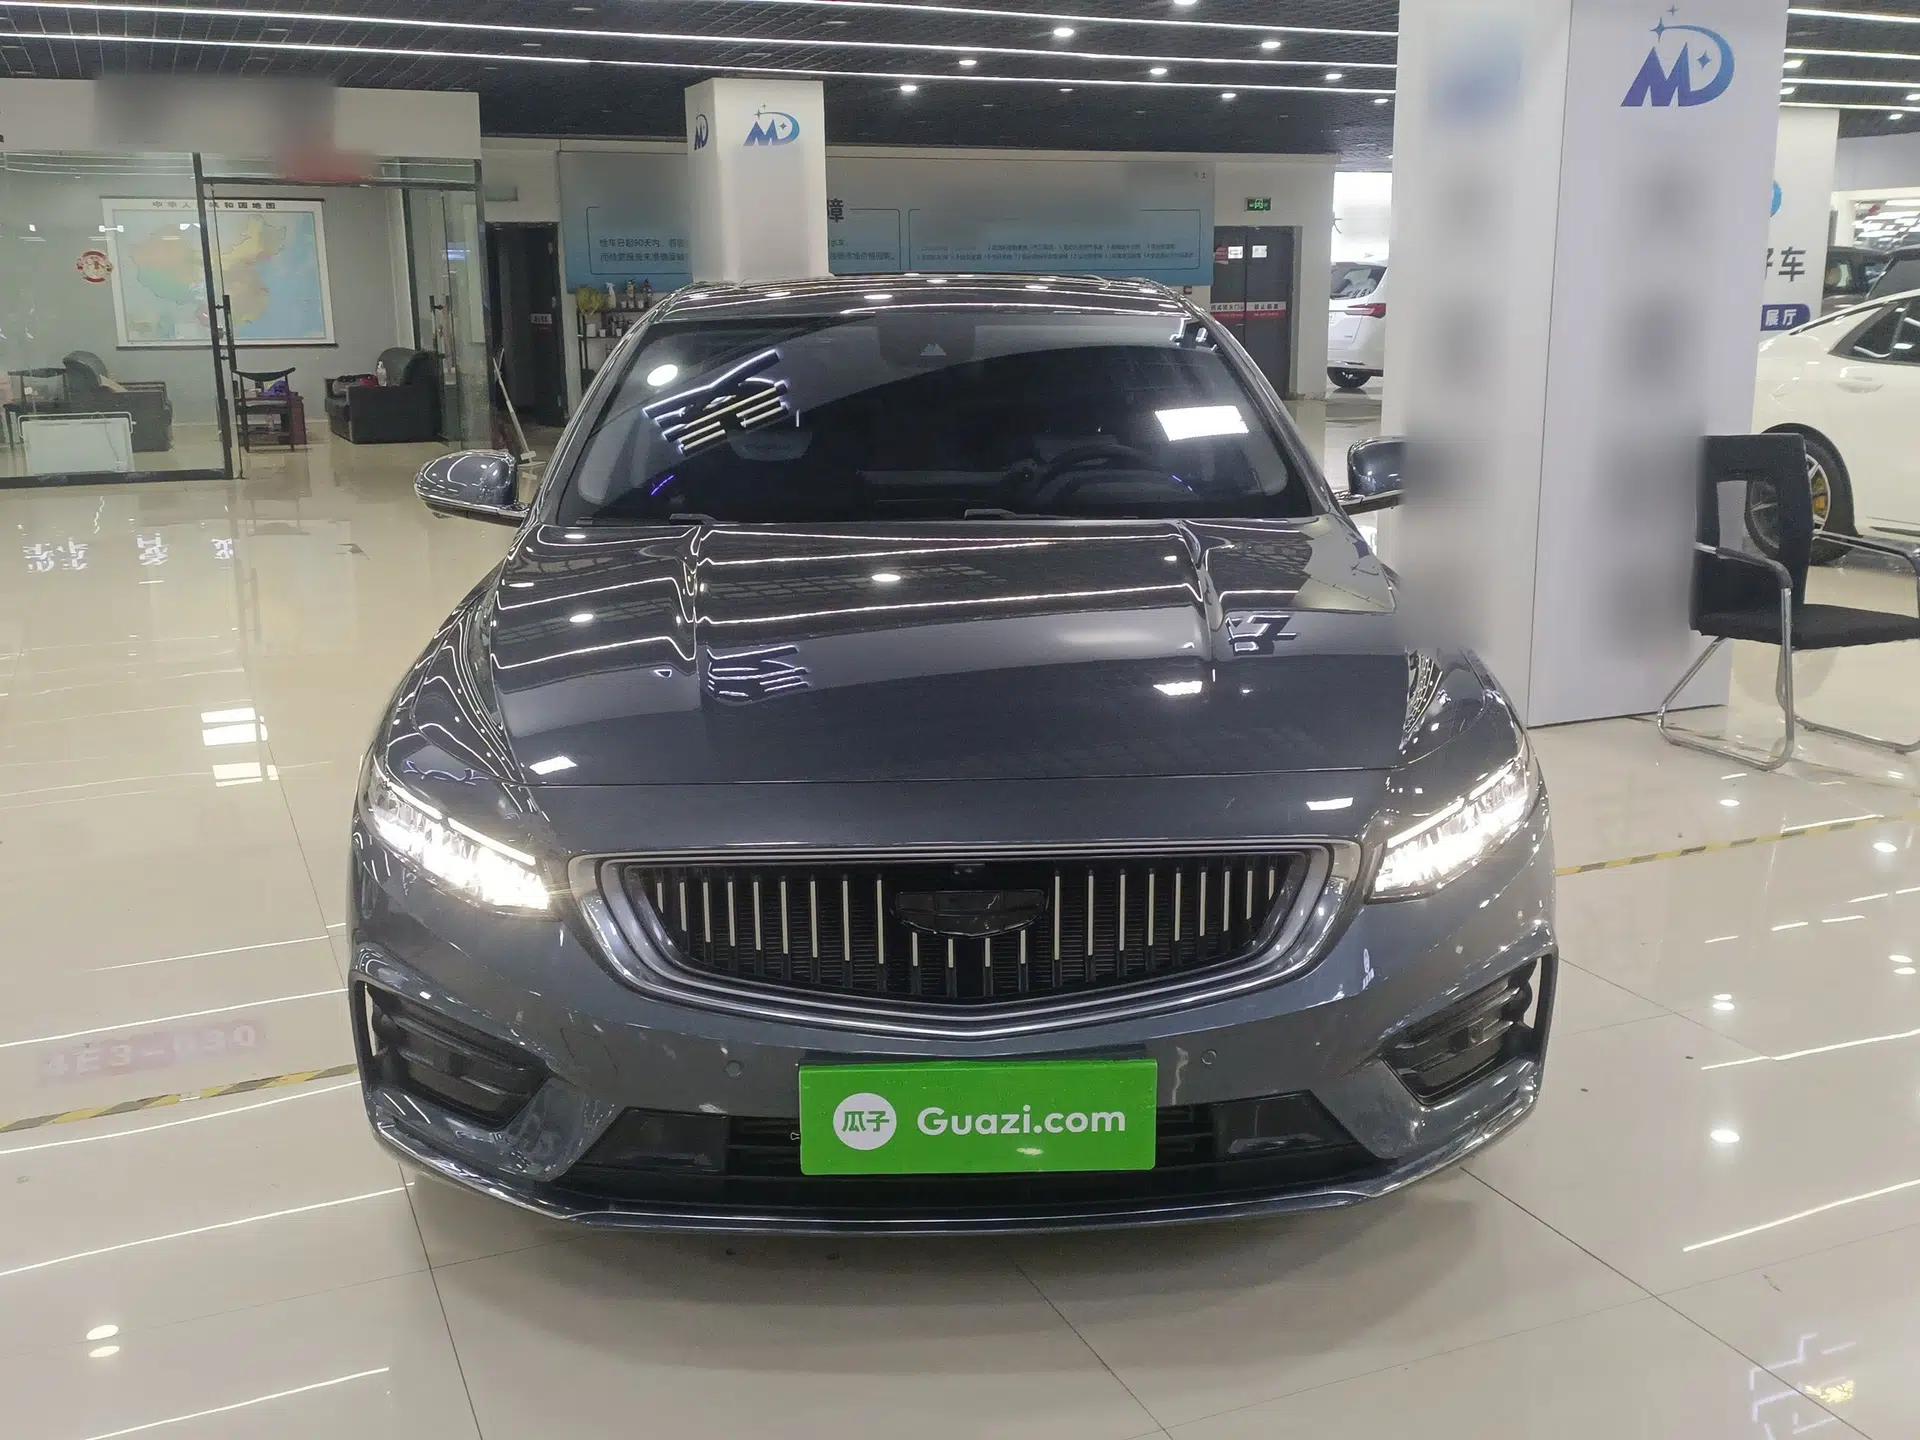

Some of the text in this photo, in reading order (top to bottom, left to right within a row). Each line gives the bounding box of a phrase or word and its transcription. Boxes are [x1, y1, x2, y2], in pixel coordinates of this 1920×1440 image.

[152, 201, 277, 210] 中华人共和国地图
[1765, 308, 1798, 327] 展厅
[841, 1104, 1127, 1136] 瓜子 Guazi.com
